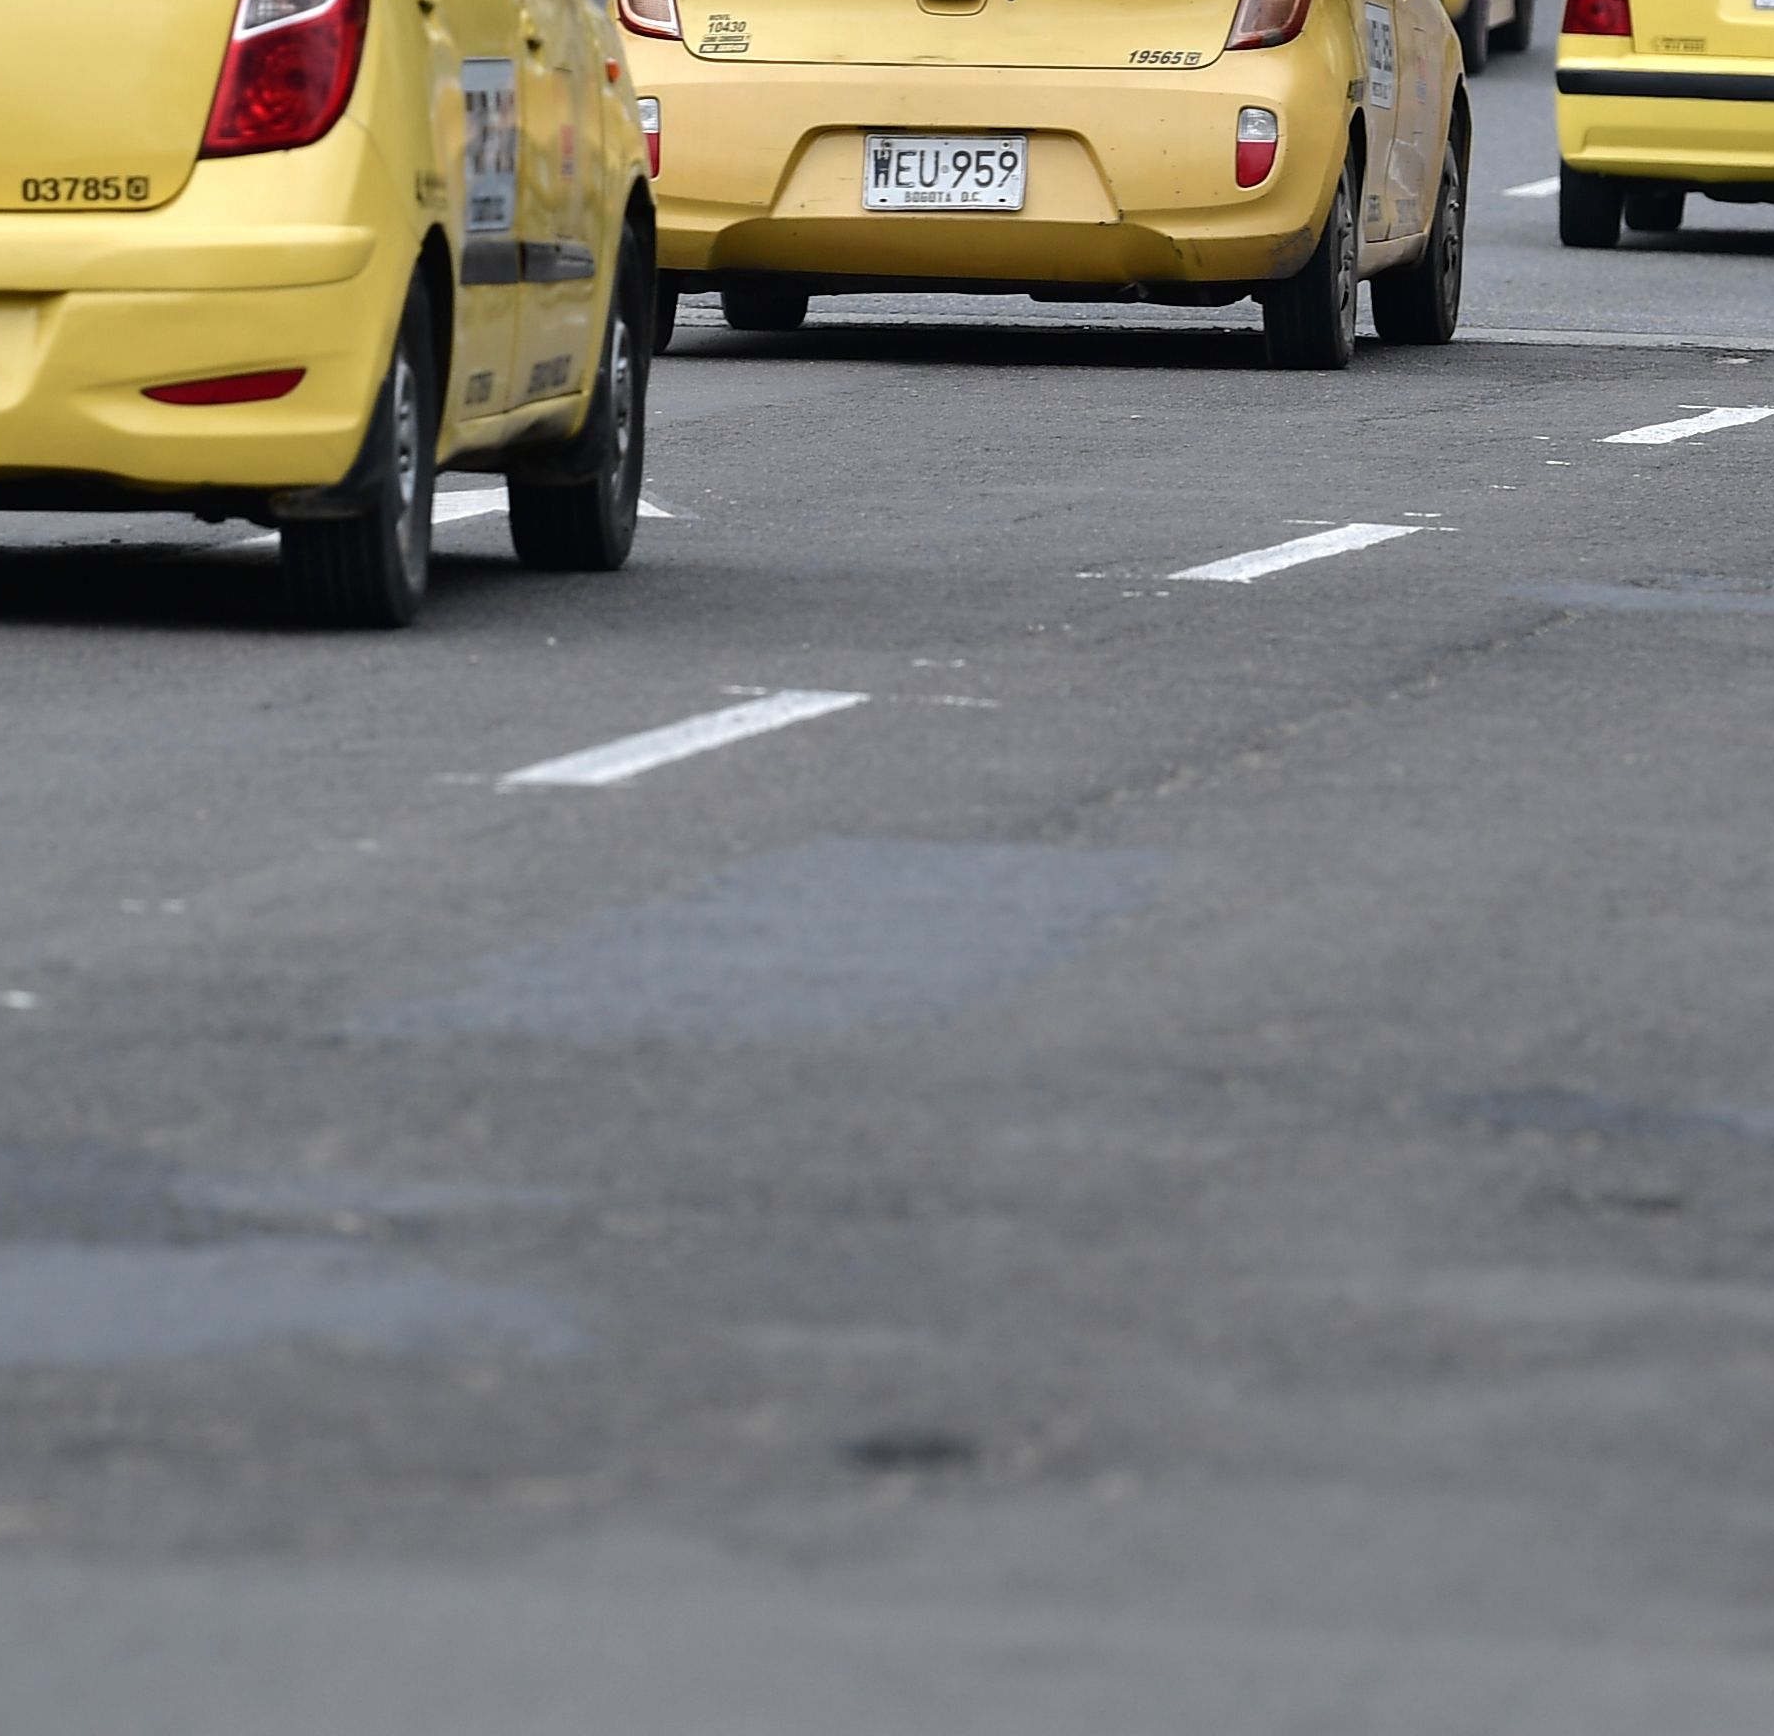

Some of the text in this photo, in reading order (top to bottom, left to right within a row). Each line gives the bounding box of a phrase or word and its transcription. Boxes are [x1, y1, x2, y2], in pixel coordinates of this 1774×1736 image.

[708, 21, 747, 33] 10430
[1128, 50, 1184, 65] 19565
[22, 177, 122, 202] 03785
[903, 191, 952, 203] BOGOTA
